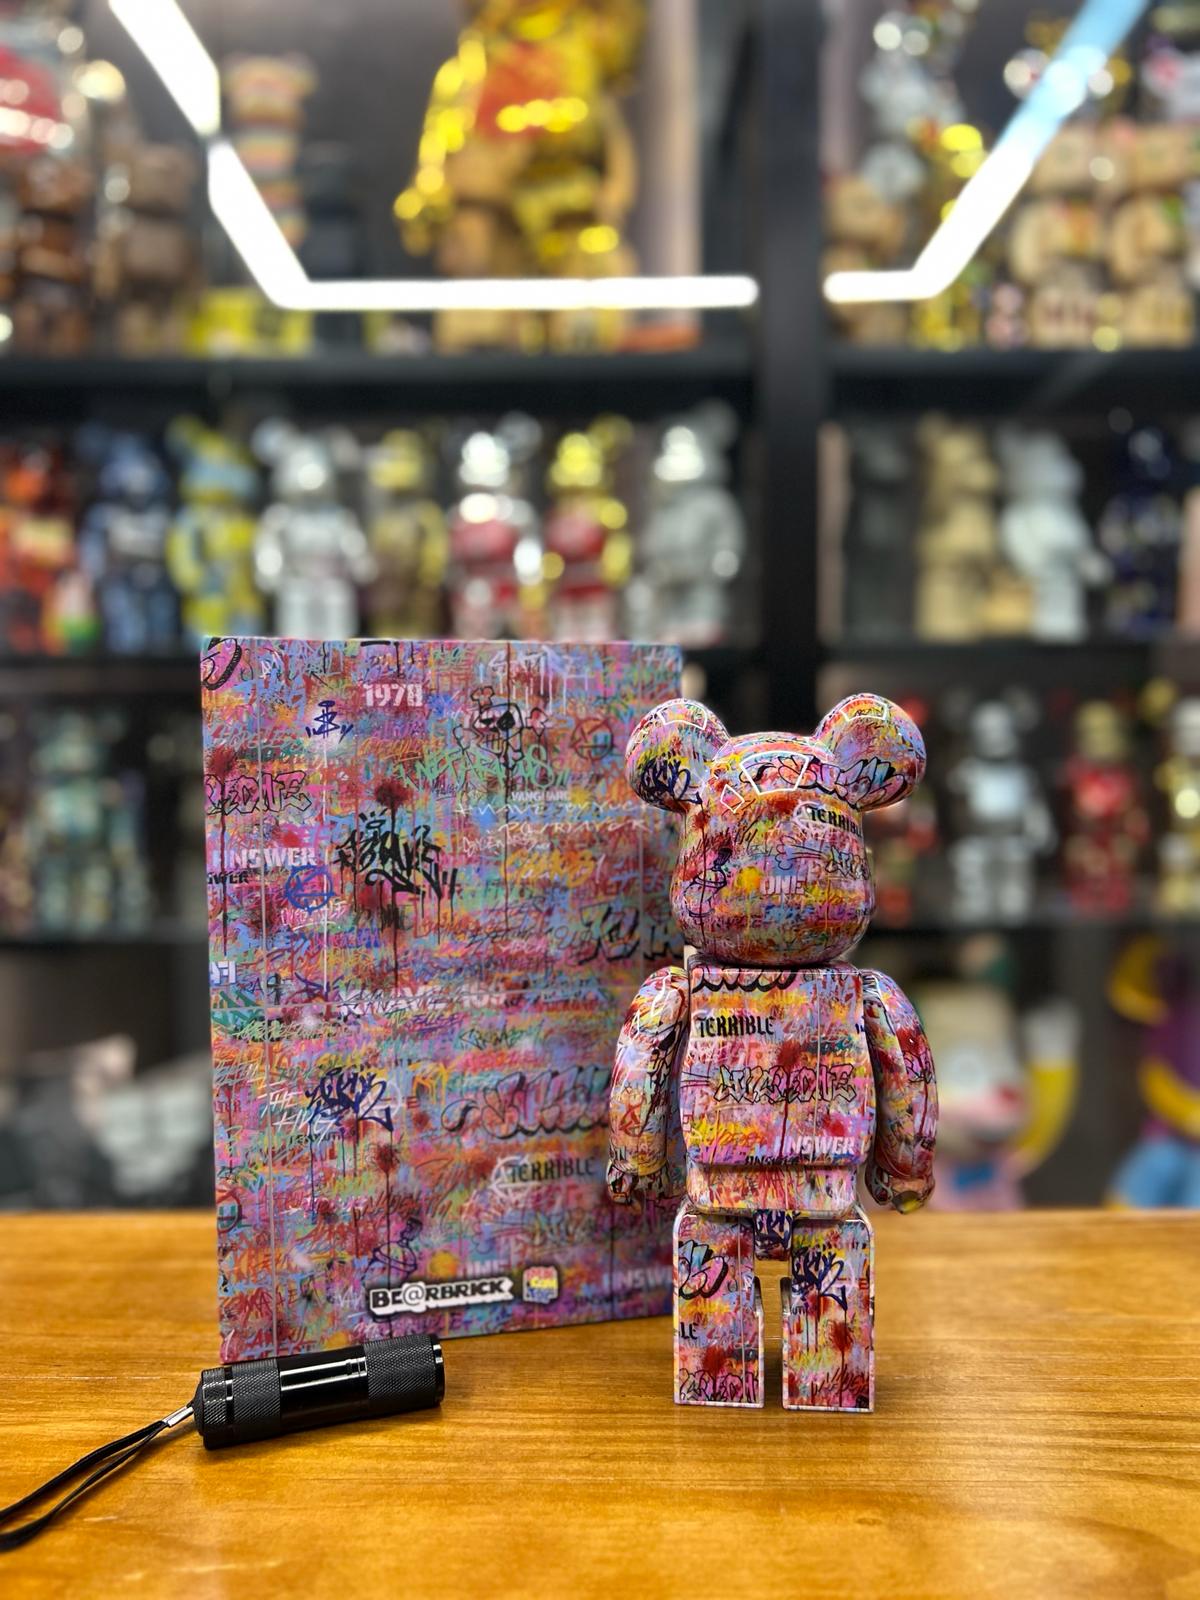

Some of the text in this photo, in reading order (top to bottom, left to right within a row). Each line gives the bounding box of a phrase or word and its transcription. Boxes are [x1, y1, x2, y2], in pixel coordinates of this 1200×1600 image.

[363, 682, 424, 708] 1978
[699, 1014, 776, 1038] TERRIBLE
[508, 1156, 595, 1183] TERRIBLE
